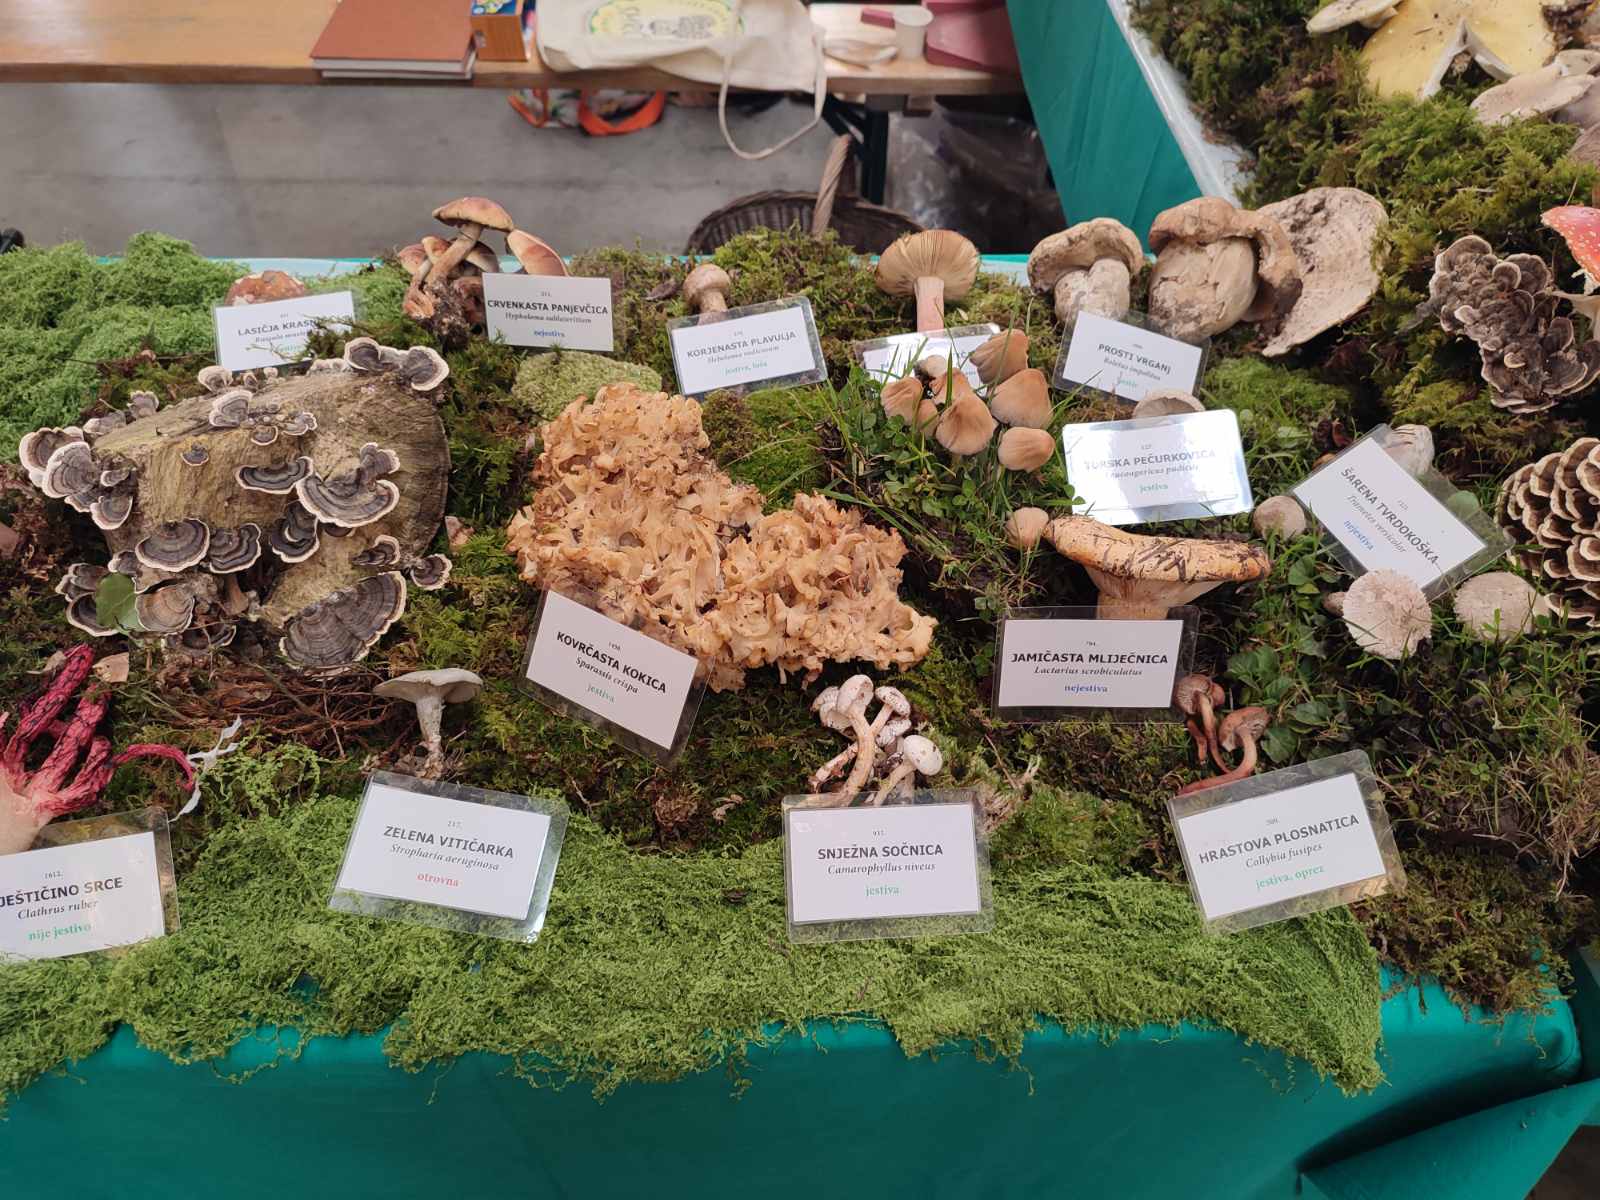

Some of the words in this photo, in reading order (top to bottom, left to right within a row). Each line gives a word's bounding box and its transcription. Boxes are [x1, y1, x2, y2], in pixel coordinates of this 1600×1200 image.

[487, 299, 548, 311] CRVENKASTA
[551, 302, 609, 315] PANJEVČICA
[237, 321, 280, 337] LASIČJA
[282, 317, 318, 331] KRASN
[686, 341, 749, 358] KORJENASTA
[750, 331, 796, 346] PLAVULJA
[1097, 343, 1134, 361] PROSTI
[1136, 354, 1172, 375] VRGANJ
[1340, 466, 1377, 506] ŠARENA
[1375, 502, 1440, 566] TVRDOKOŠKA
[1343, 519, 1375, 552] nejestiva
[557, 630, 620, 671] KOVRČASTA
[622, 661, 667, 694] KOKICA
[1011, 649, 1083, 664] JAMIČASTA
[1088, 650, 1168, 665] MLIJEČNICA
[575, 656, 613, 681] Sparassis
[613, 675, 639, 694] crispa
[1034, 665, 1079, 675] Lactarius
[1080, 665, 1143, 676] scrobiculatus
[586, 683, 615, 704] jestiva
[1064, 683, 1108, 694] nejestiva
[383, 825, 434, 844] ZELENA
[438, 834, 514, 859] VITIČARKA
[1198, 836, 1272, 865] HRASTOVA
[1273, 813, 1360, 845] PLOSNATICA
[389, 843, 443, 862] Stropharia
[444, 852, 499, 871] aeruginosa
[817, 843, 878, 860] SNJEŽNA
[881, 841, 943, 857] SOČNICA
[1245, 851, 1287, 869] Collybia
[1286, 843, 1323, 861] fusipes
[416, 871, 459, 888] otrovna
[827, 862, 903, 876] Camarophyllus
[903, 862, 936, 872] niveus
[1255, 872, 1293, 892] jestiva,
[1293, 865, 1324, 882] oprez
[83, 876, 124, 894] SRCE
[864, 884, 900, 898] jestiva
[17, 903, 66, 920] Clathrus
[67, 899, 99, 912] ruber
[28, 927, 53, 942] nije
[53, 923, 92, 939] jestivo
